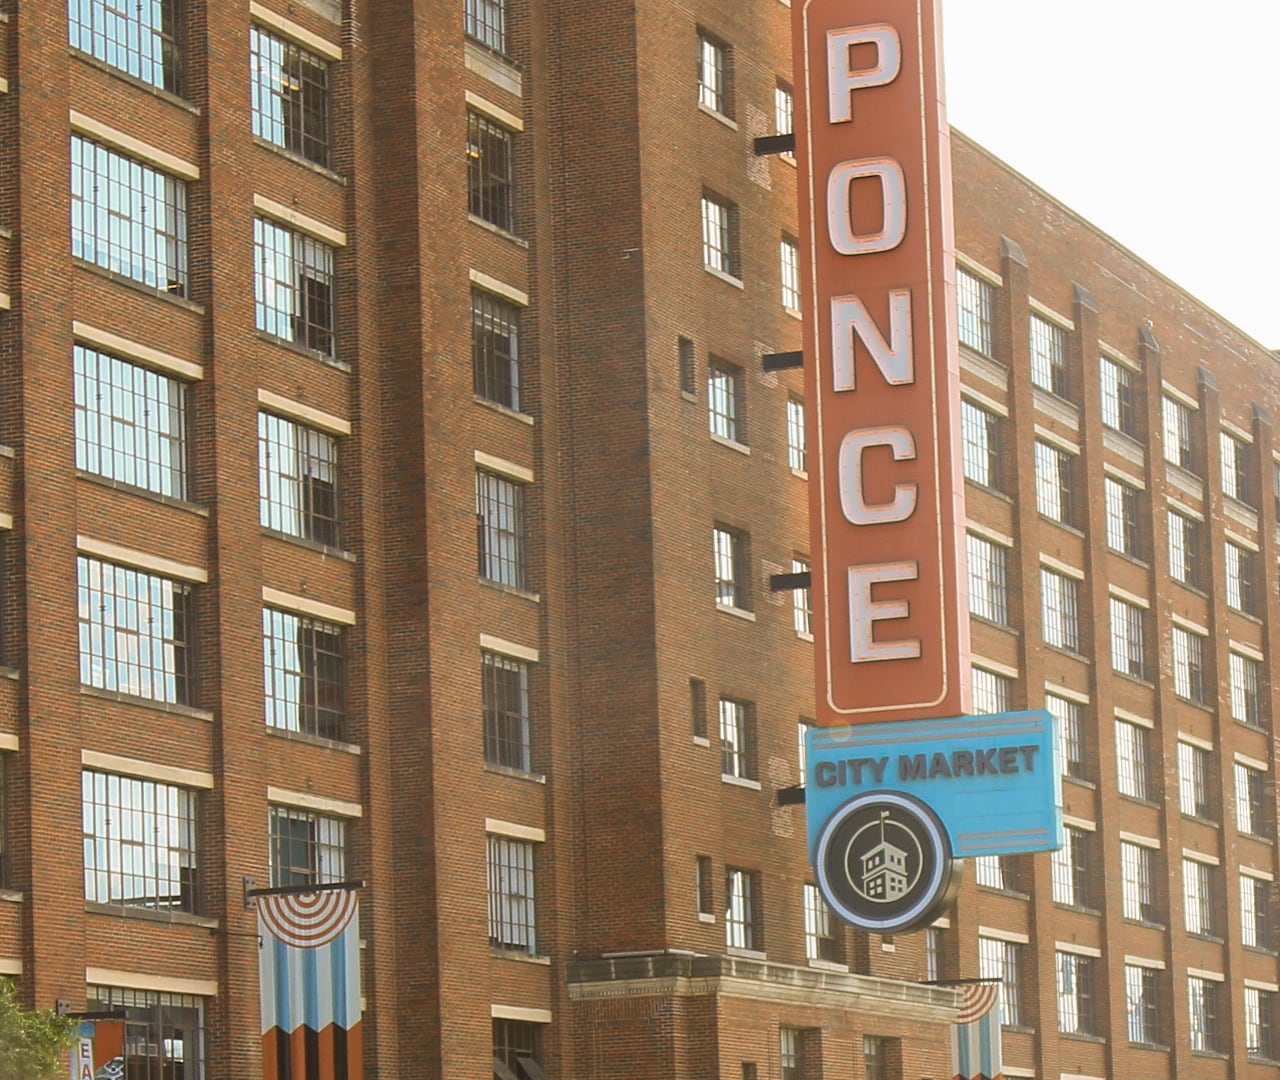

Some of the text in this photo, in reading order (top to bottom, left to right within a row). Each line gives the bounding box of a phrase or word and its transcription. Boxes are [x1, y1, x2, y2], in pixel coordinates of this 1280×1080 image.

[826, 22, 921, 664] PONCE
[814, 744, 1041, 788] CITY MARKET
